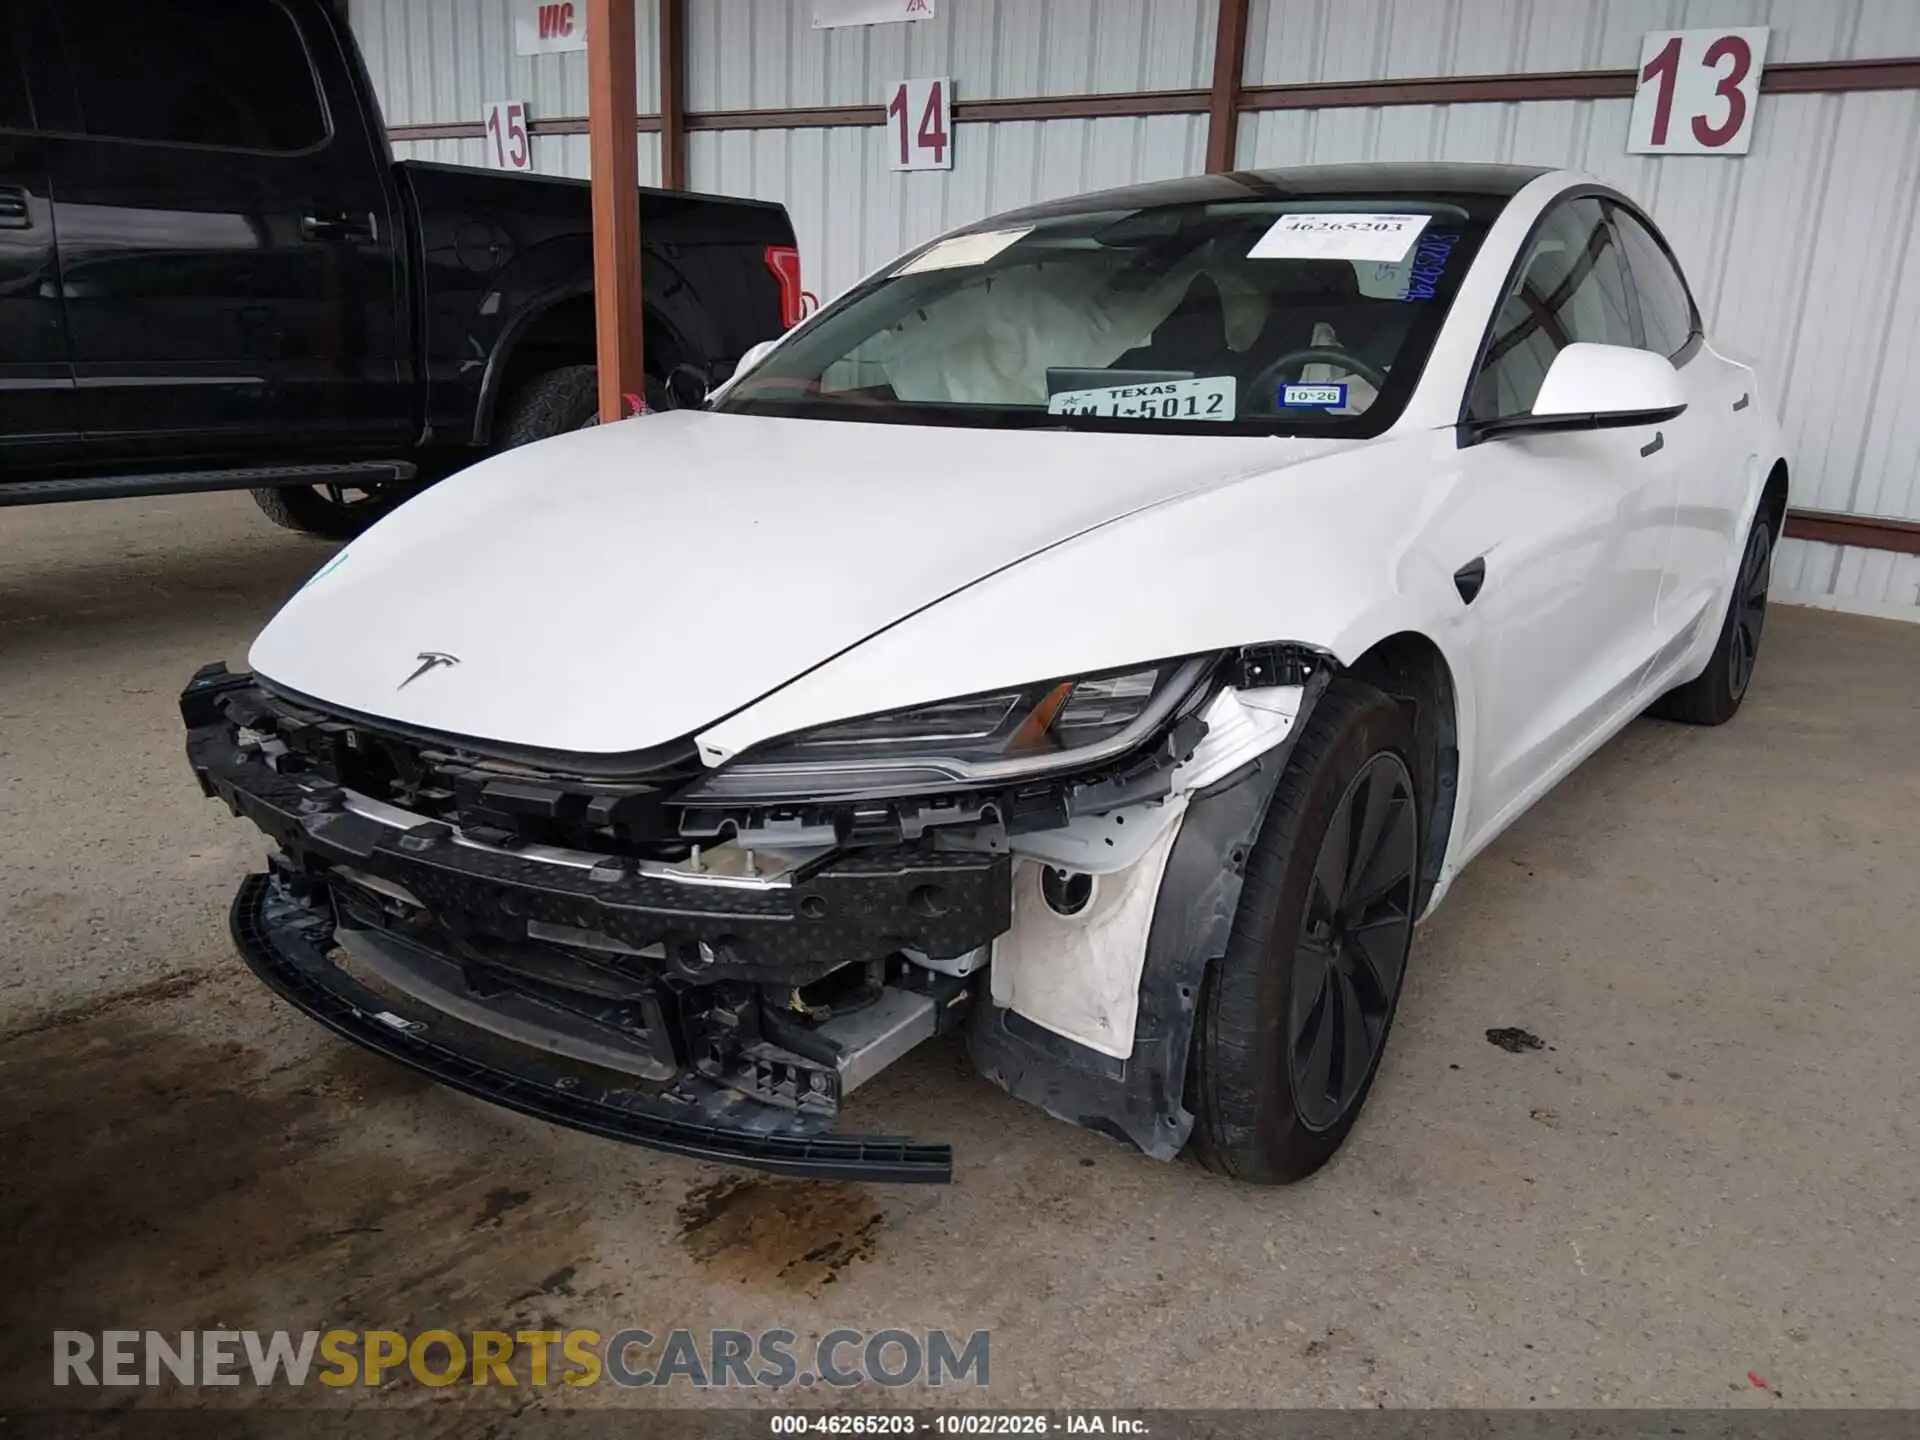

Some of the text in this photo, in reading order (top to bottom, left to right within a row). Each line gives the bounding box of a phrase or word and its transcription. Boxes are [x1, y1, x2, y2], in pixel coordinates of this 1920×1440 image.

[538, 2, 574, 39] VIC
[1641, 35, 1752, 148] 13
[487, 104, 527, 169] 15
[888, 80, 948, 165] 14
[1284, 221, 1404, 232] 46265203
[1108, 384, 1177, 399] TEXAS
